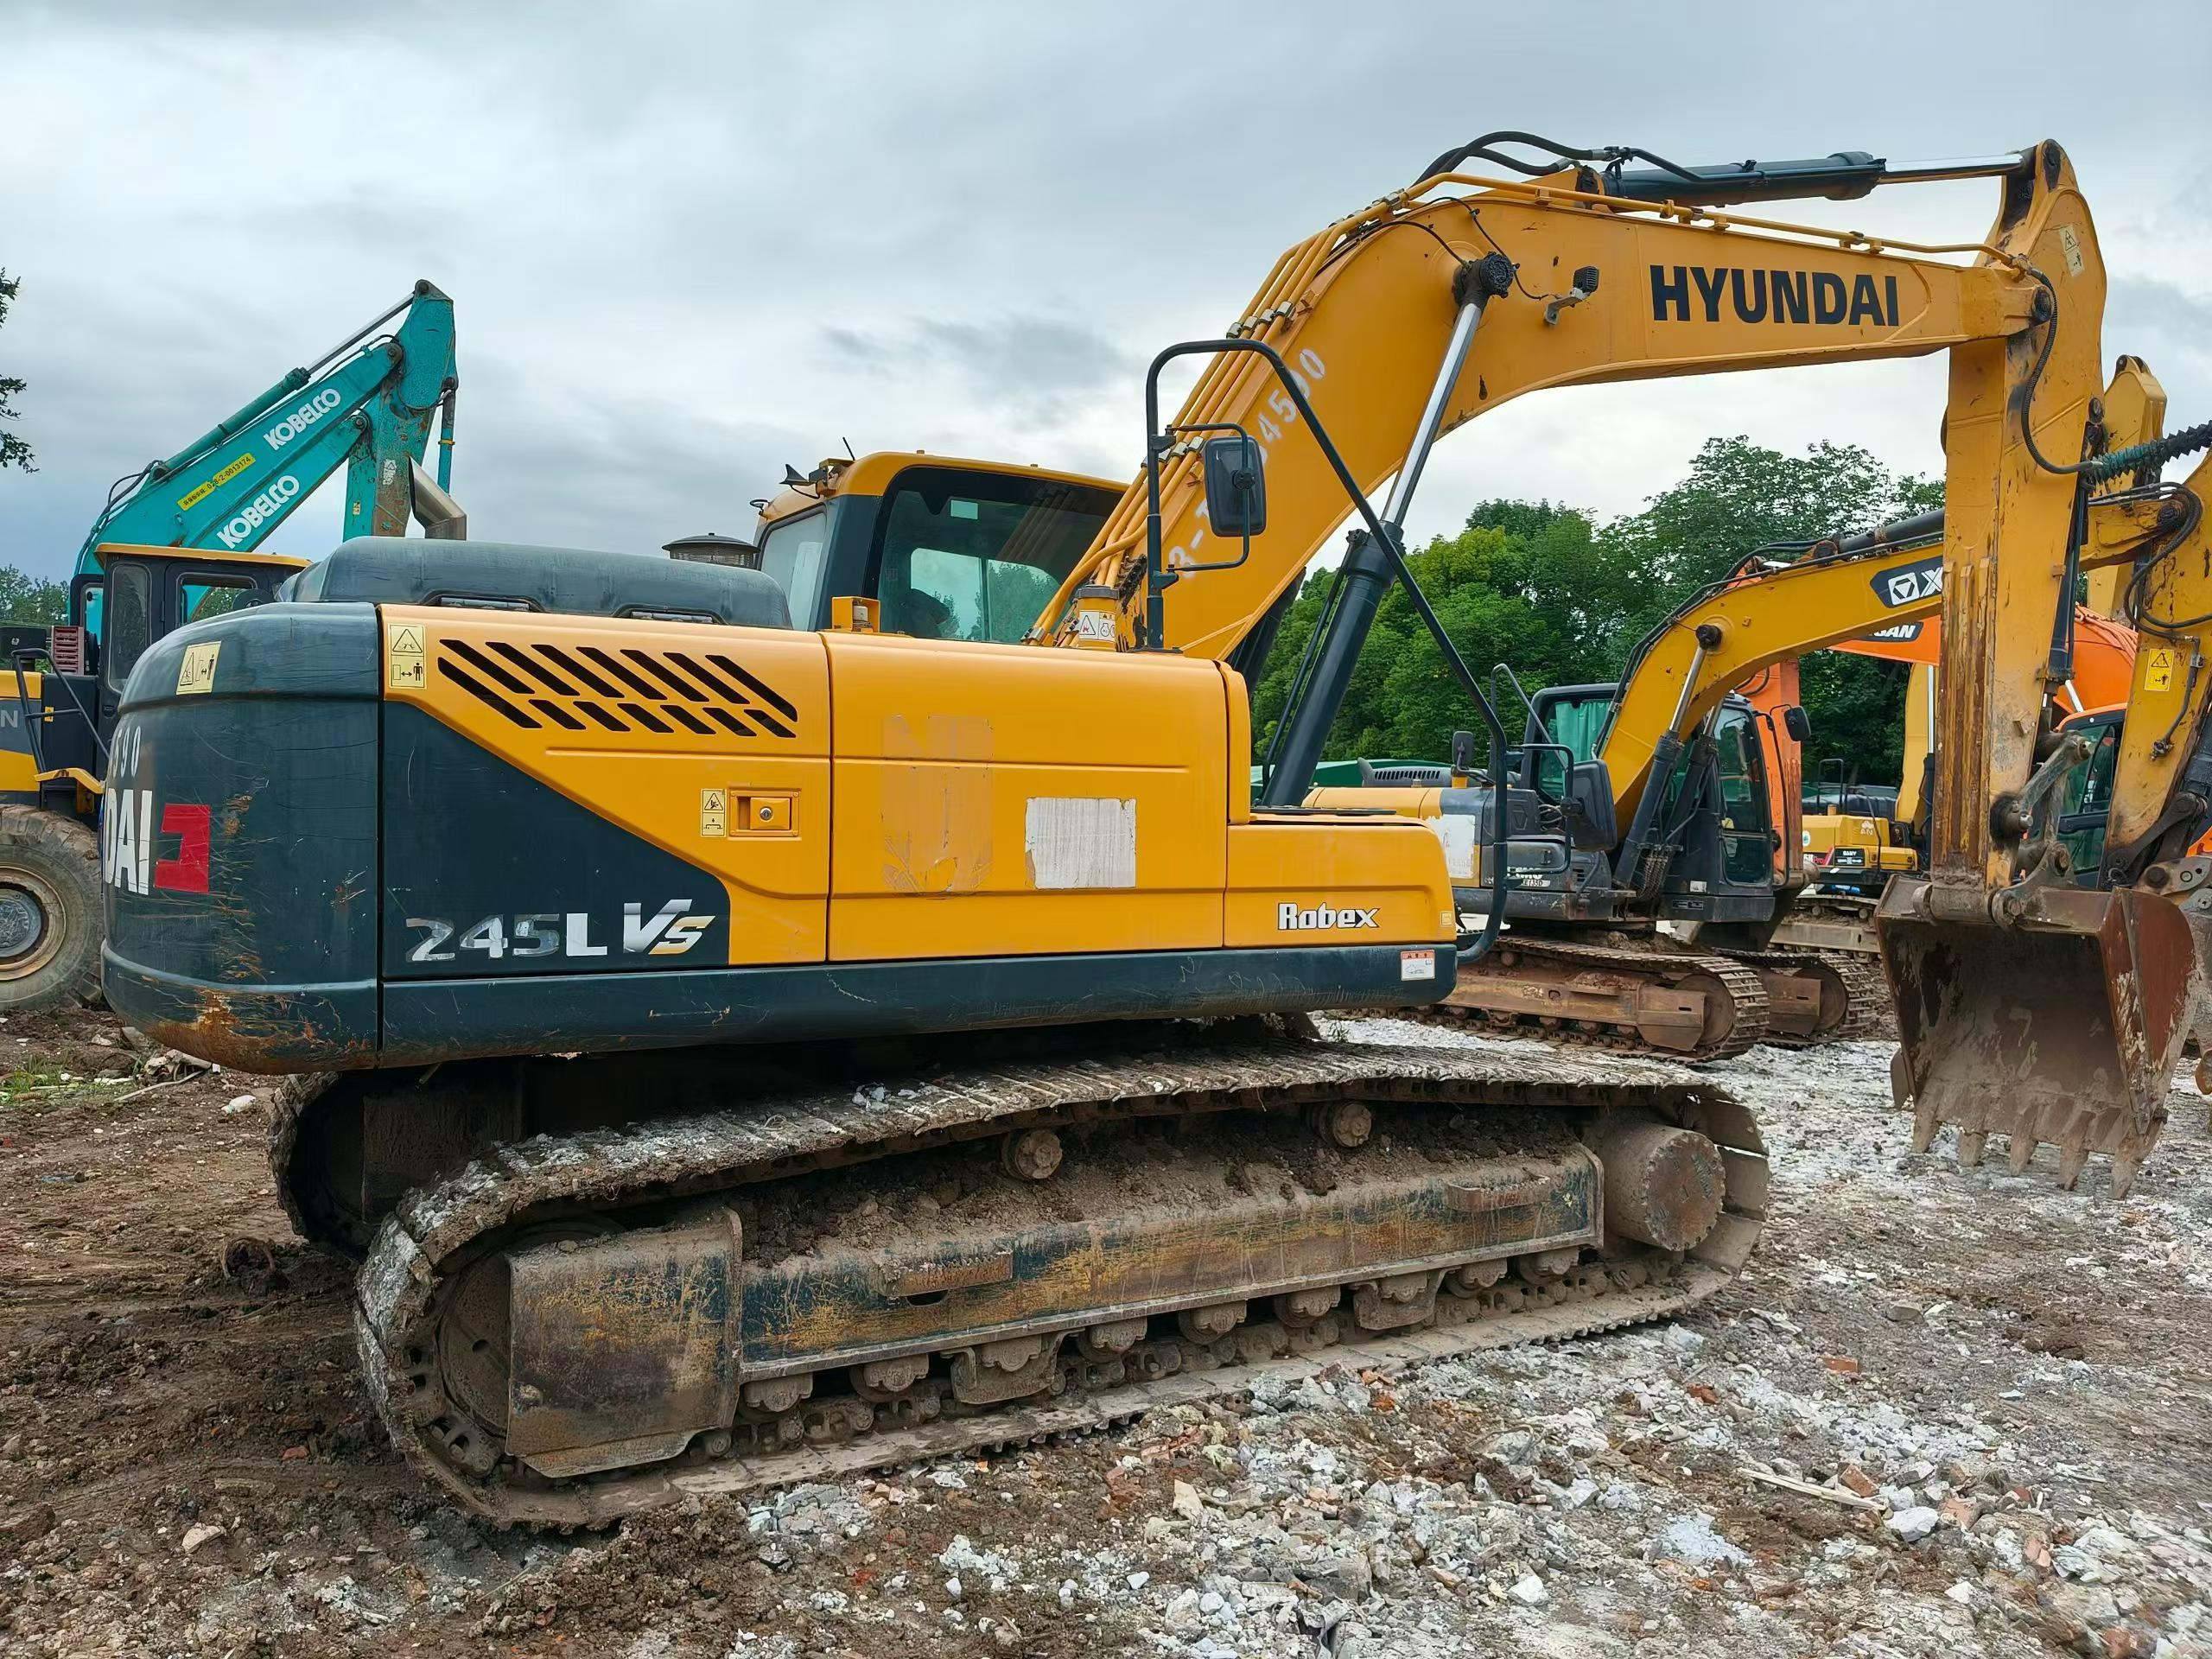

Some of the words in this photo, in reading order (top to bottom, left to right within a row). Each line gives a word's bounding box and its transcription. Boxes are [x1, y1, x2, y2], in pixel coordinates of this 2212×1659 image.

[1649, 264, 1900, 327] HYUNDAI
[263, 388, 341, 451] KOBELCO
[207, 456, 251, 489] 08-2-0013174
[216, 474, 300, 550] KOBELCO
[405, 912, 608, 963] 245L
[1278, 902, 1380, 930] Robex
